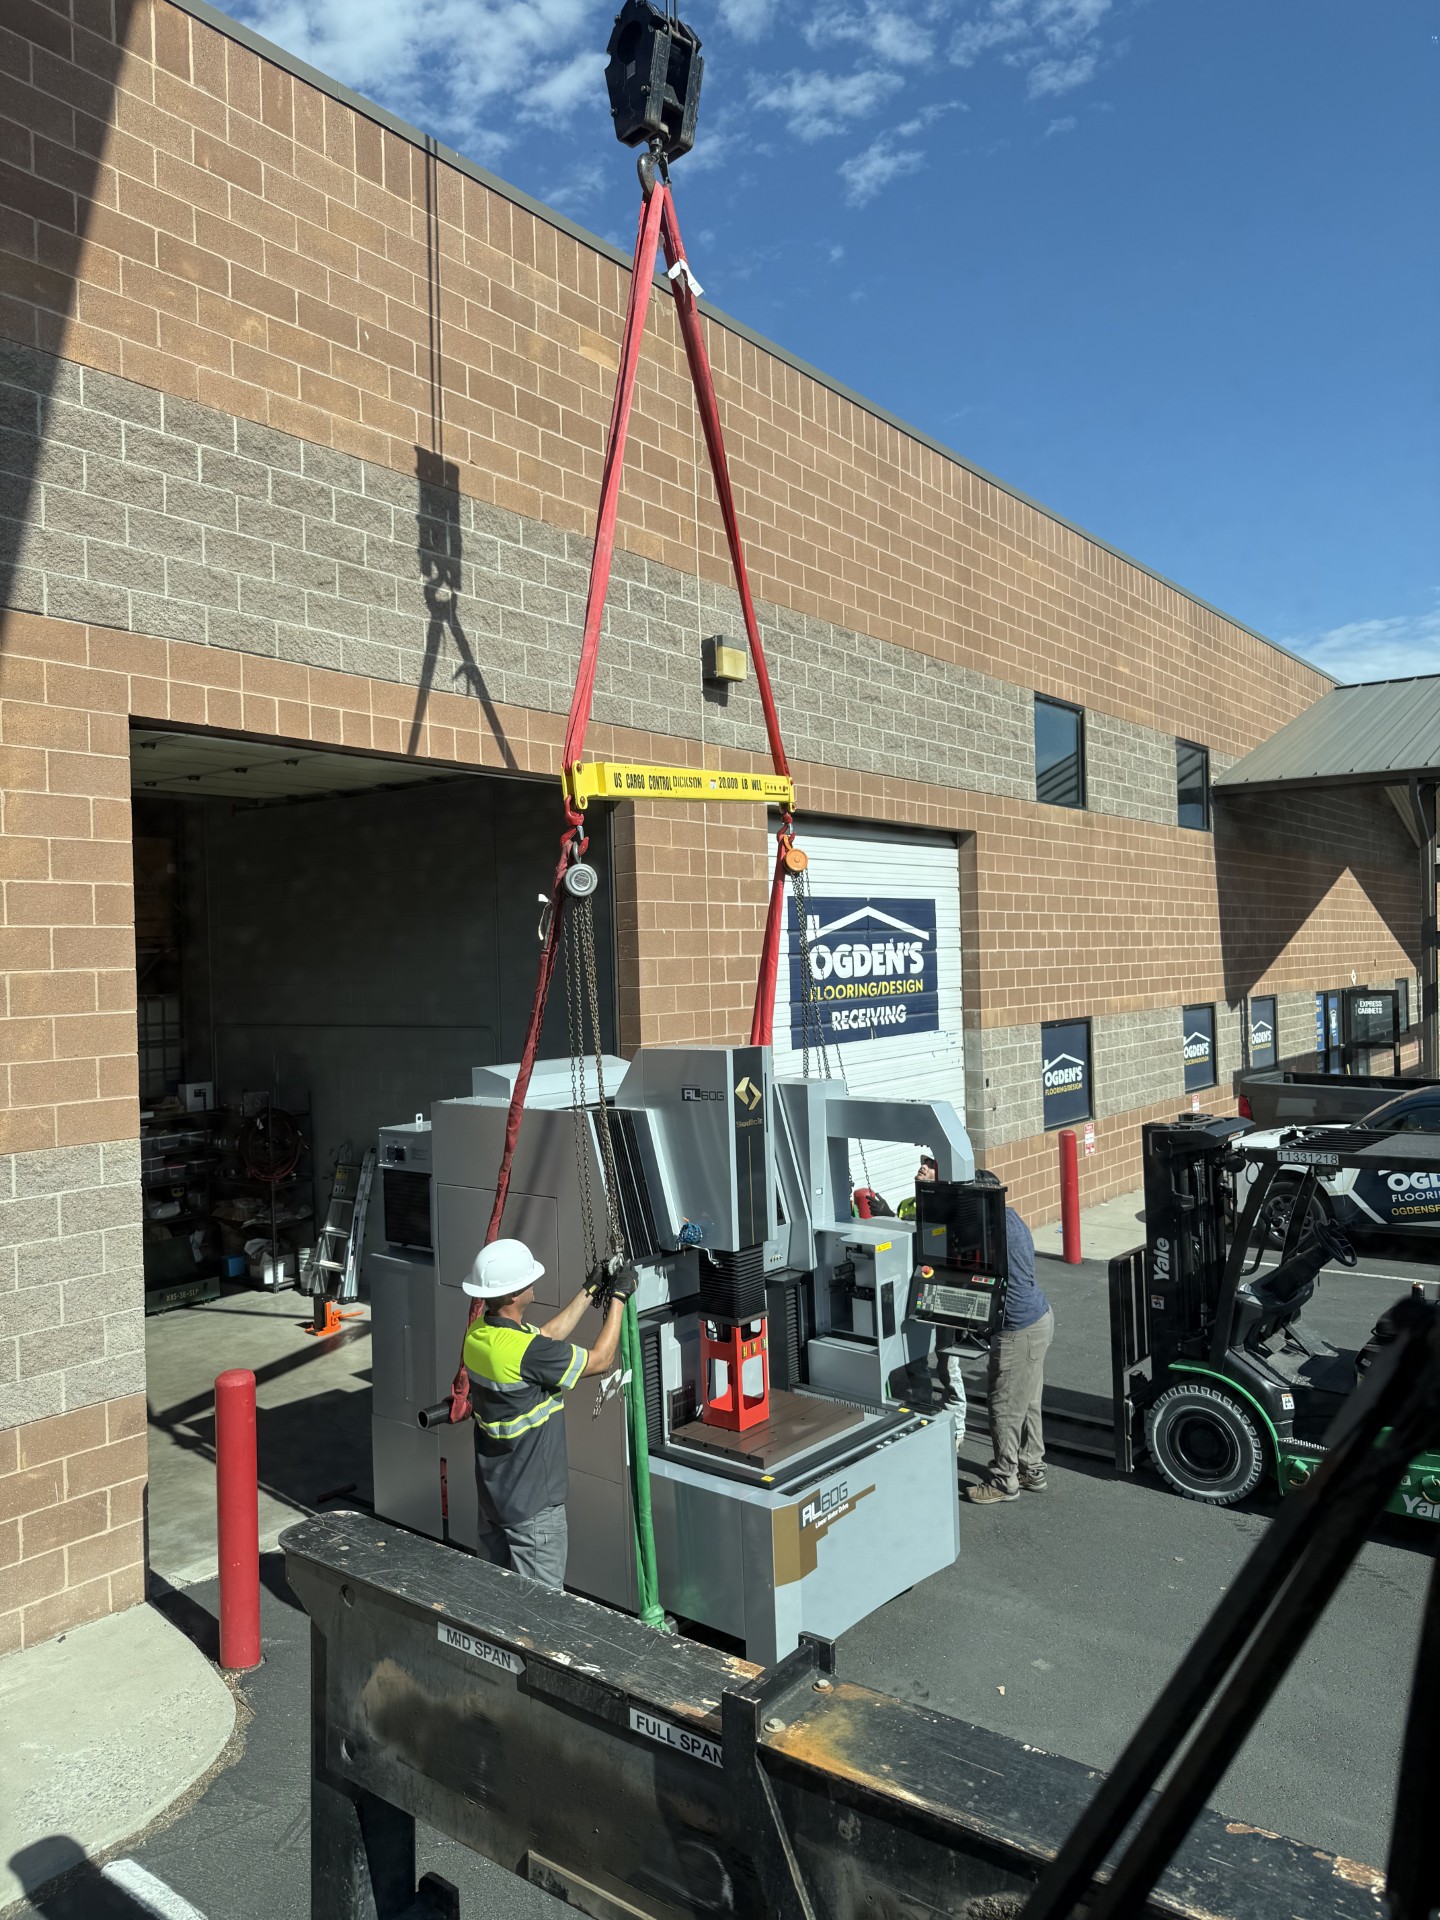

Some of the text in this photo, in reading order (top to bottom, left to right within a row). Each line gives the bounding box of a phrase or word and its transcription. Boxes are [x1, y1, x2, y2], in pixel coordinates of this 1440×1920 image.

[613, 772, 622, 788] US
[626, 773, 645, 789] CARGO
[648, 775, 672, 791] CONTROL
[741, 778, 748, 790] LB
[810, 941, 924, 981] OGDEN'S
[1359, 1000, 1382, 1008] EXPRESS
[831, 1004, 907, 1031] RECEIVING
[1184, 1042, 1209, 1059] OGDEN'S
[1044, 1066, 1083, 1087] OGDEN'S
[1278, 1151, 1338, 1165] 11331218
[1391, 1190, 1440, 1203] FLOORI
[1153, 1237, 1170, 1280] Yale
[446, 1628, 511, 1669] MID SPAN
[636, 1713, 723, 1766] FULL SPAN
